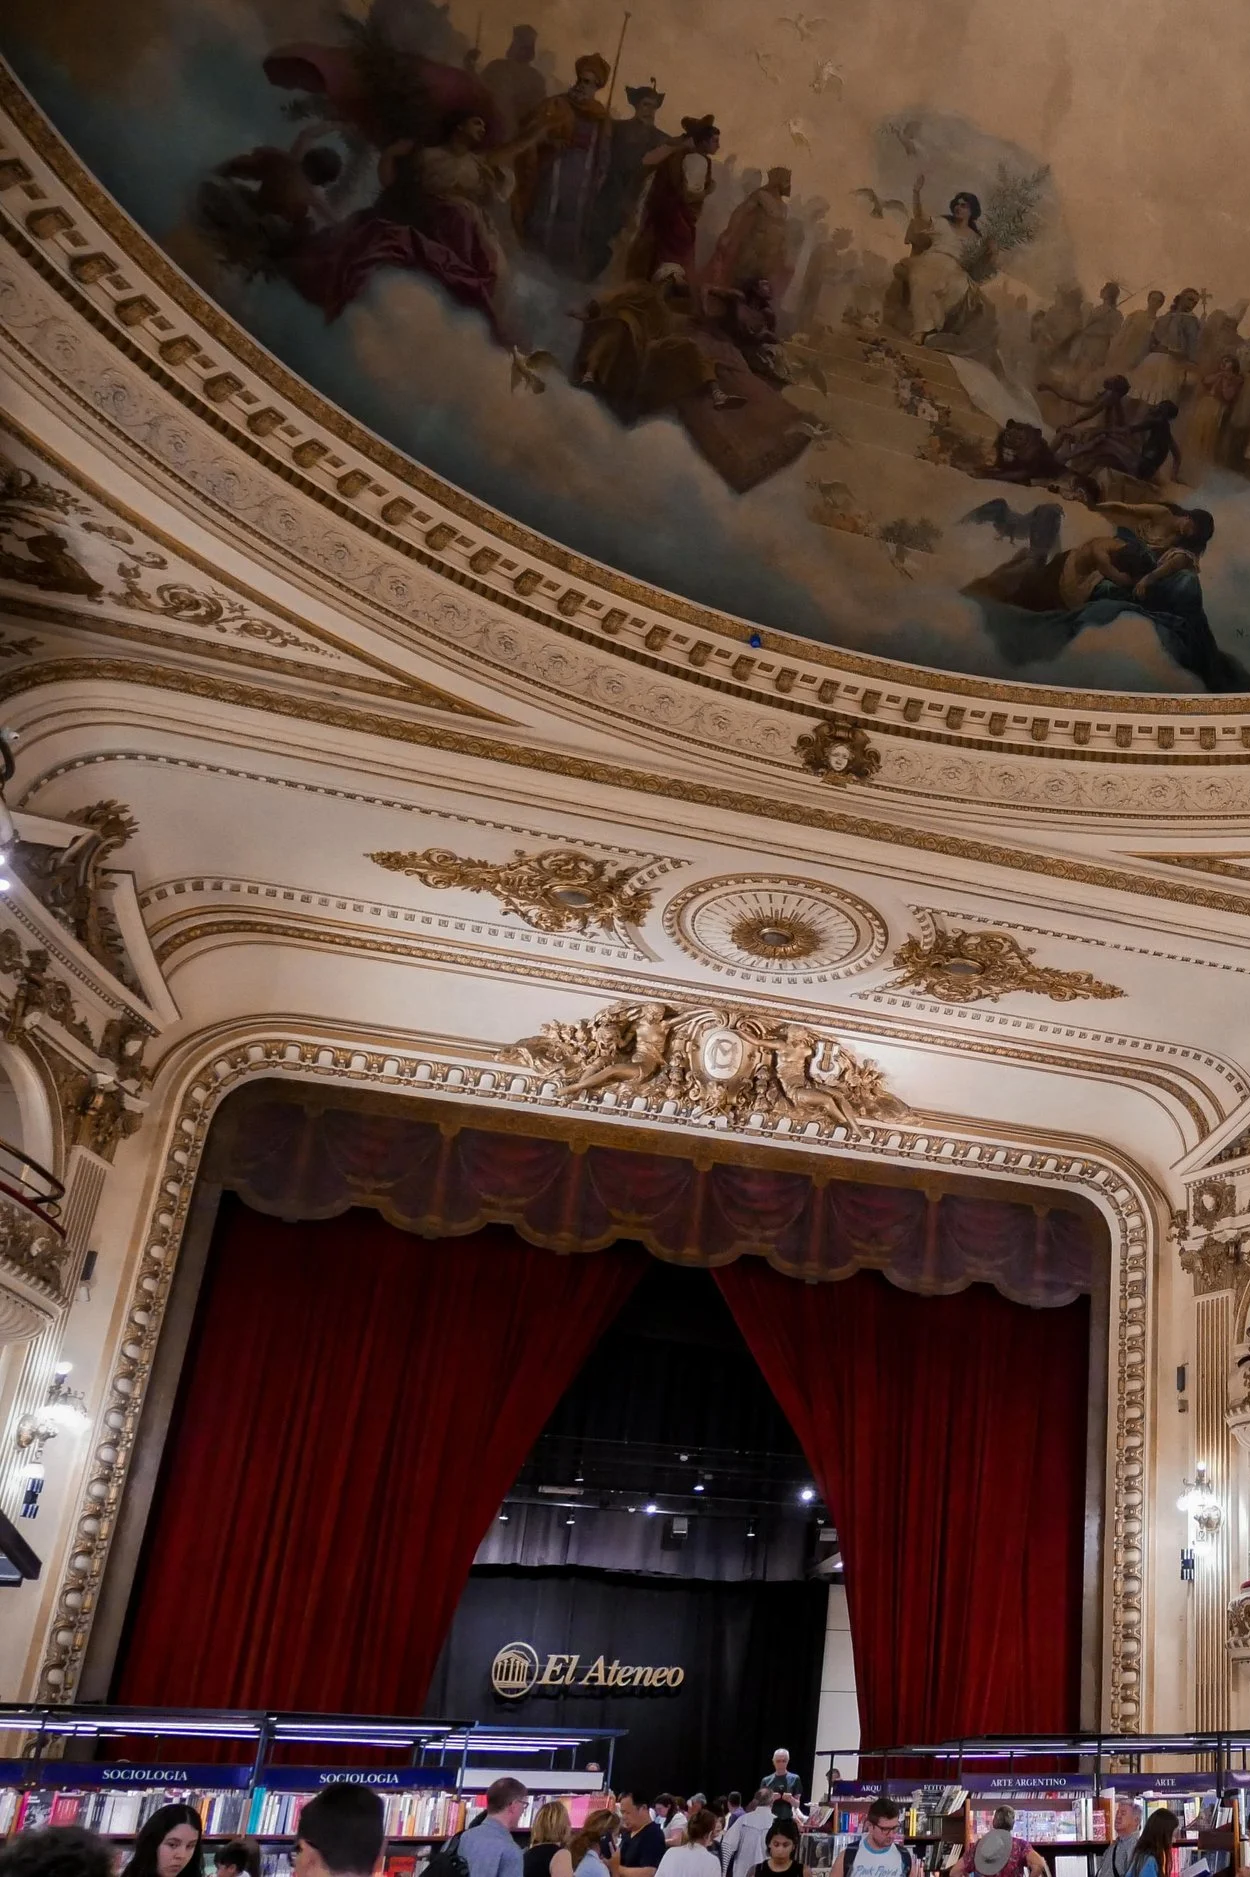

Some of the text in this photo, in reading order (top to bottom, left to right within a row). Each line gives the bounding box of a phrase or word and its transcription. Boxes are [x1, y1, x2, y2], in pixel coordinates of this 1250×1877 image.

[537, 1654, 685, 1687] El Ateneo
[102, 1769, 188, 1781] SOCIOLOGIA
[319, 1773, 399, 1784] SOCIOLOGIA
[990, 1777, 1067, 1788] ARTE ARGENTINO
[1155, 1778, 1176, 1787] ARTE
